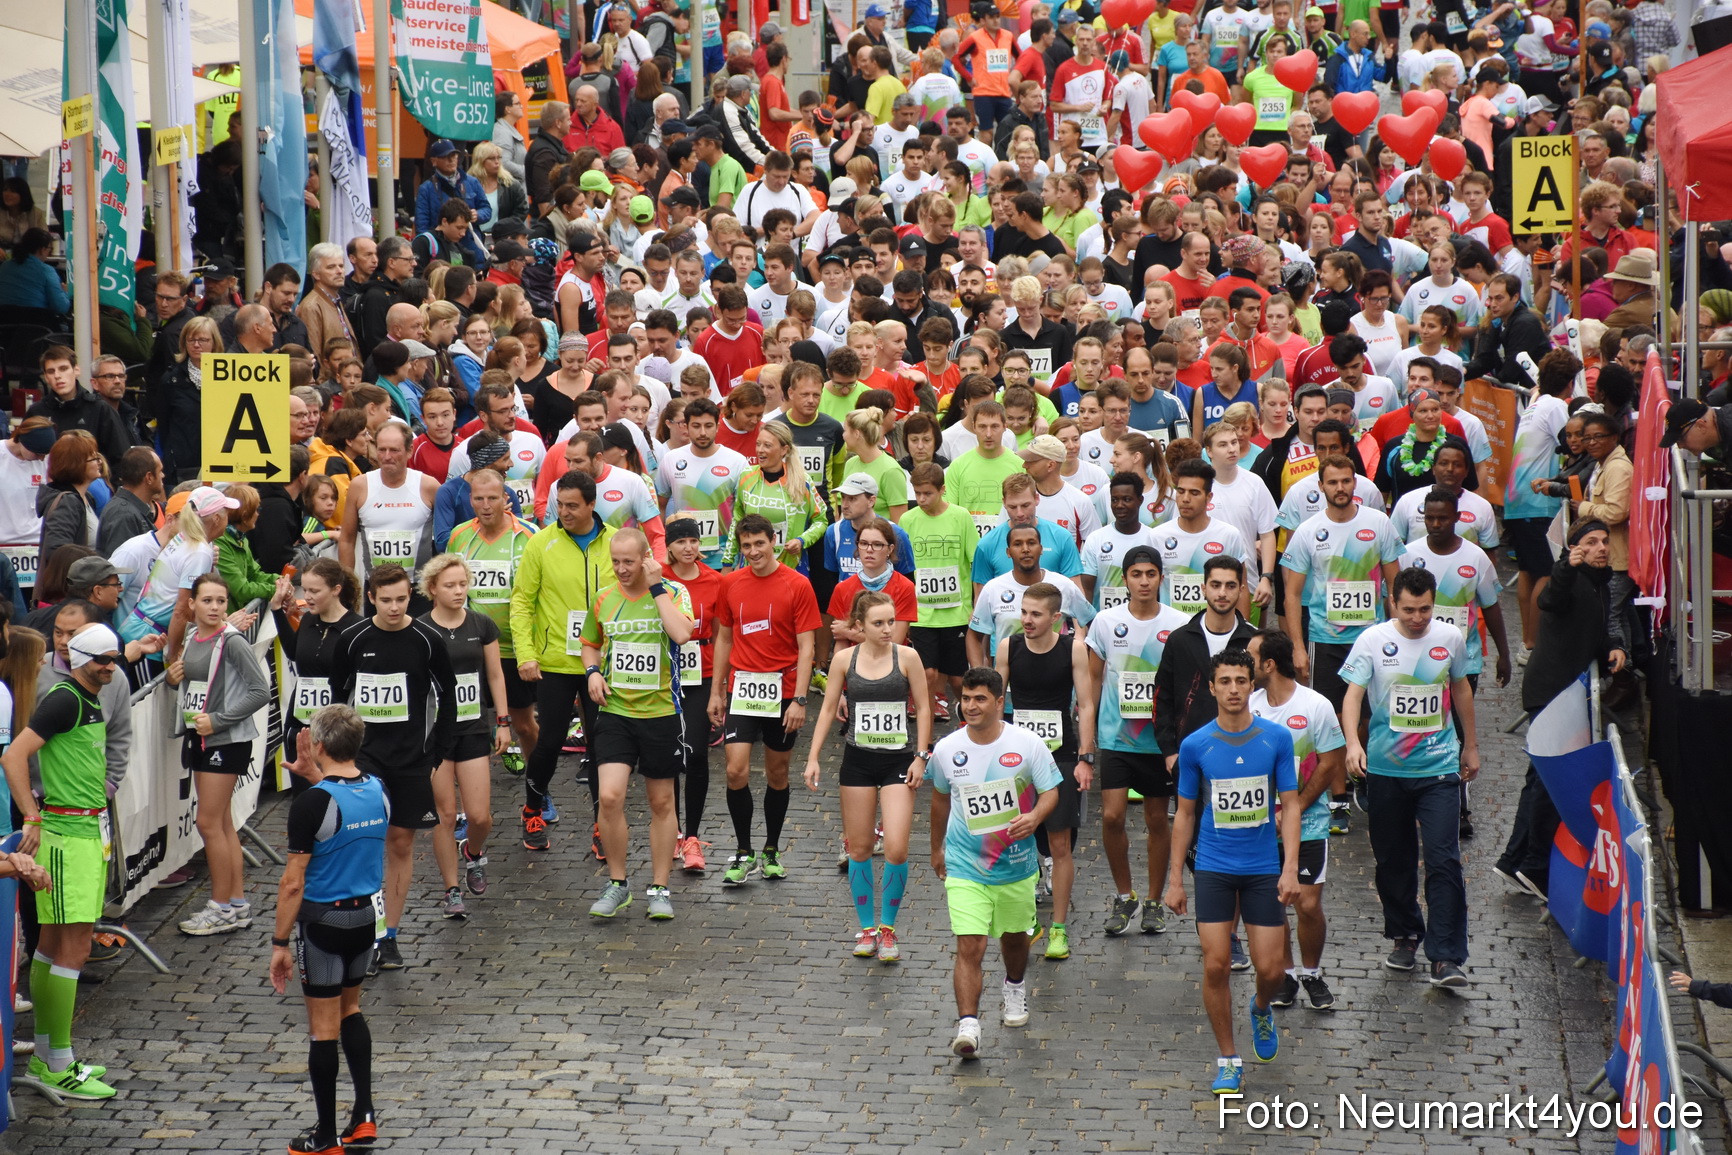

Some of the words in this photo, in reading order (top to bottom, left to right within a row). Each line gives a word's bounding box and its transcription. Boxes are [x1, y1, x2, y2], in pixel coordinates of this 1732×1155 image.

[1218, 31, 1238, 40] 5206
[989, 54, 1008, 64] 3106
[453, 102, 489, 125] 6352
[1262, 102, 1285, 112] 2353
[1080, 117, 1100, 128] 2226
[1520, 139, 1572, 158] Block
[1526, 166, 1566, 212] A
[213, 359, 281, 382] Block
[220, 393, 272, 454] A
[1290, 461, 1317, 476] MAX
[373, 540, 412, 556] 5015
[921, 576, 957, 594] 5013
[477, 590, 499, 598] Roman
[928, 596, 951, 604] Hannes
[1332, 591, 1372, 609] 5219
[1341, 612, 1363, 620] Fabian
[603, 619, 662, 636] BOCK
[616, 653, 657, 672] 5269
[626, 675, 642, 684] Jens
[300, 689, 330, 707] 516
[361, 685, 403, 704] 5170
[457, 685, 477, 703] 00
[738, 682, 778, 700] 5089
[369, 708, 392, 716] Stefan
[746, 702, 767, 711] Stefan
[1395, 696, 1439, 714] 5210
[861, 713, 902, 732] 5181
[1289, 717, 1307, 727] Hervis
[1407, 718, 1428, 727] Khalil
[867, 735, 896, 744] Vanessa
[1001, 755, 1021, 764] Hervis
[967, 790, 1014, 816] 5314
[1218, 788, 1265, 811] 5249
[346, 822, 359, 831] TSG
[369, 817, 384, 826] Roth
[1229, 813, 1256, 822] Ahmad
